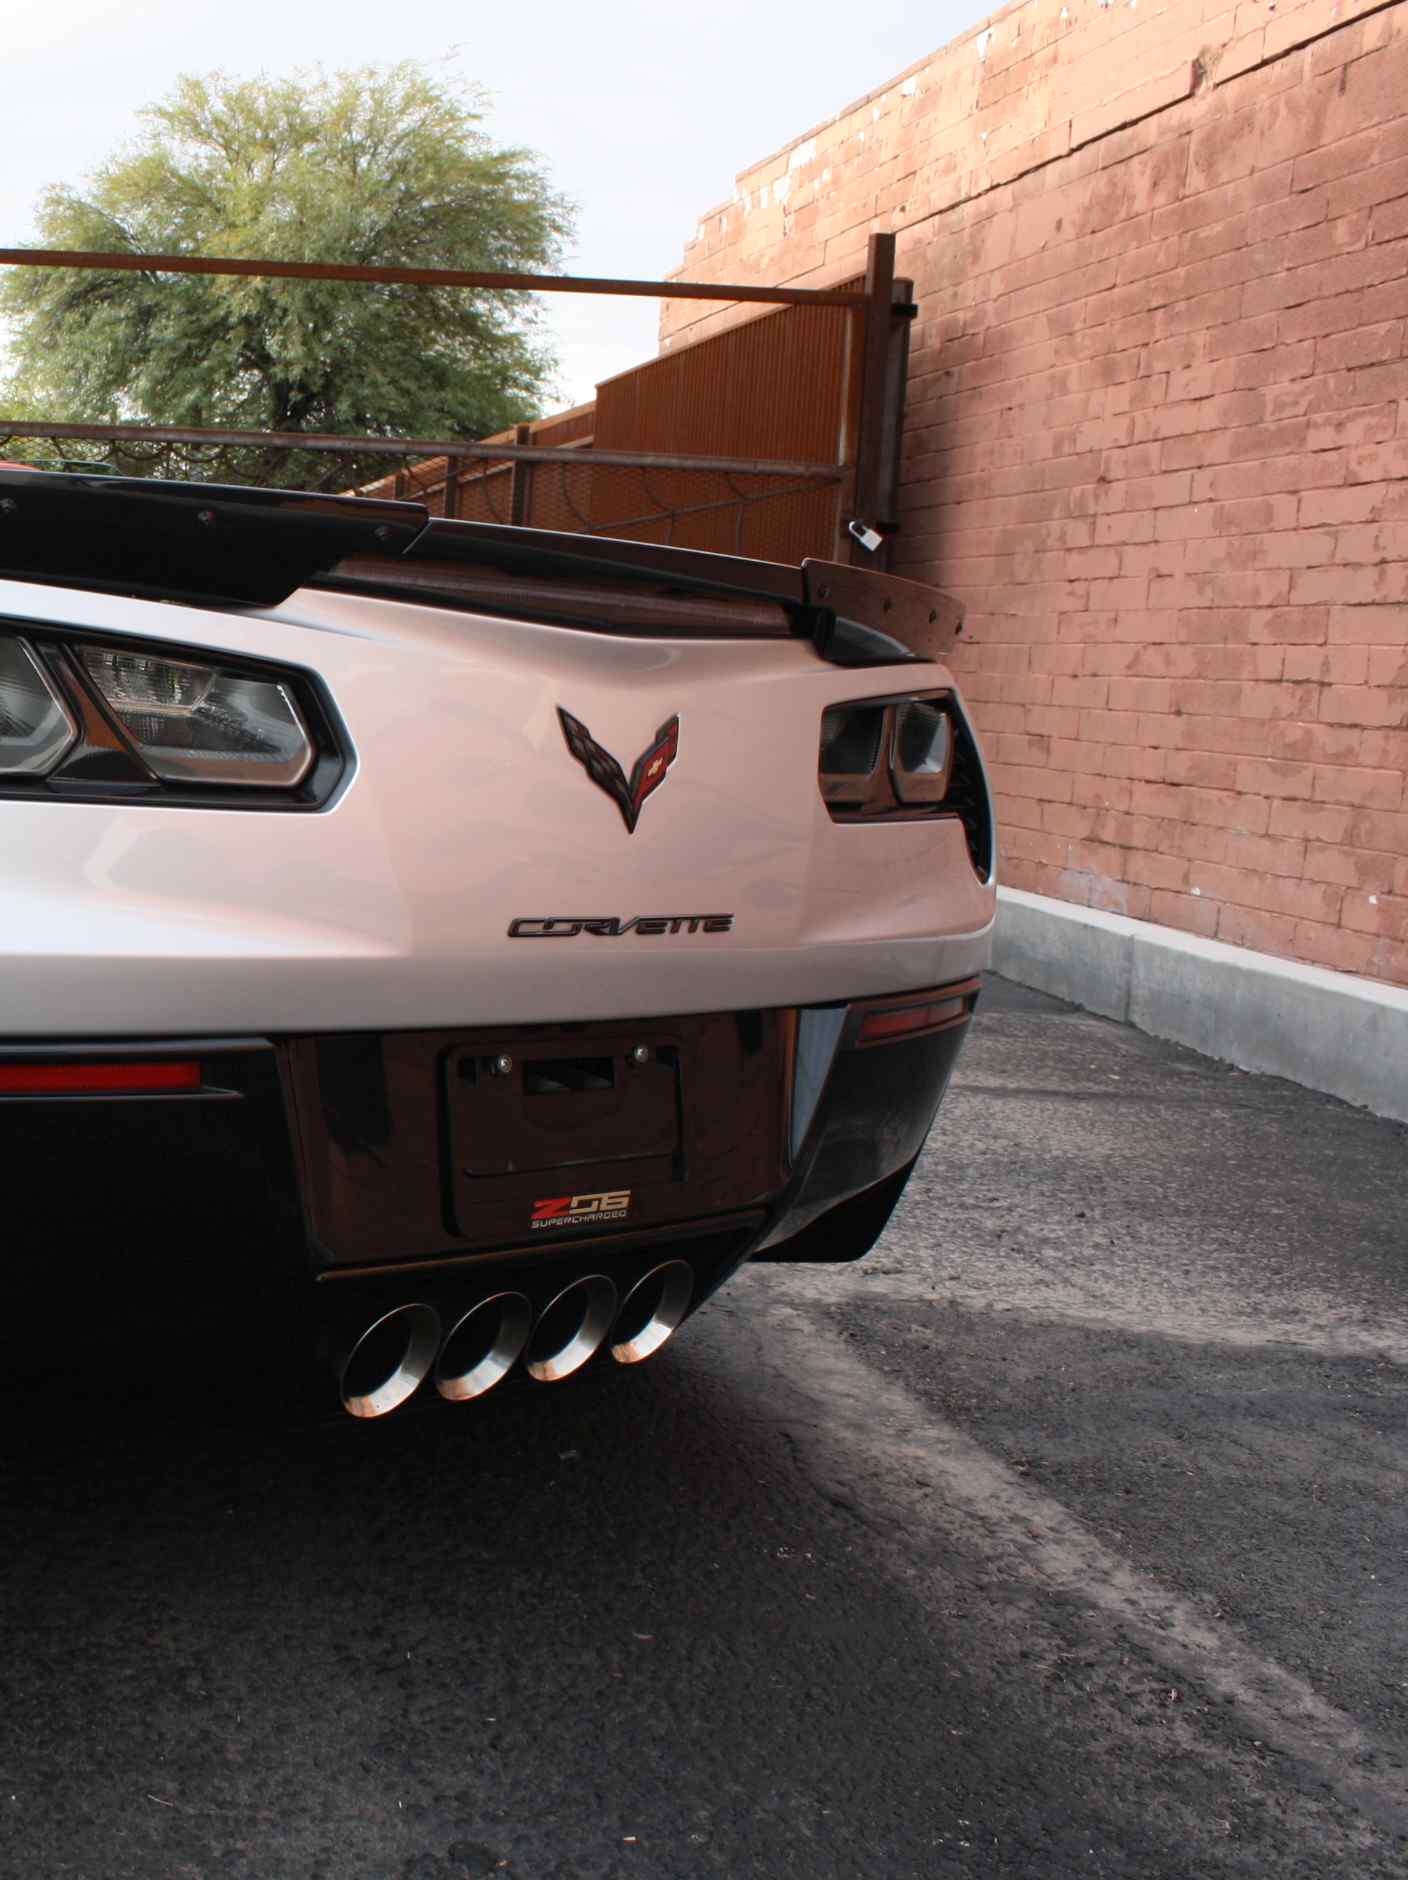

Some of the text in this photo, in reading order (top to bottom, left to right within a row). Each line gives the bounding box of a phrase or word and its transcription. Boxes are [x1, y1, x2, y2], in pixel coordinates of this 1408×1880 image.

[508, 914, 734, 938] CORVETTE
[531, 1190, 631, 1220] Z06
[532, 1209, 627, 1229] SUPERCHARGED
